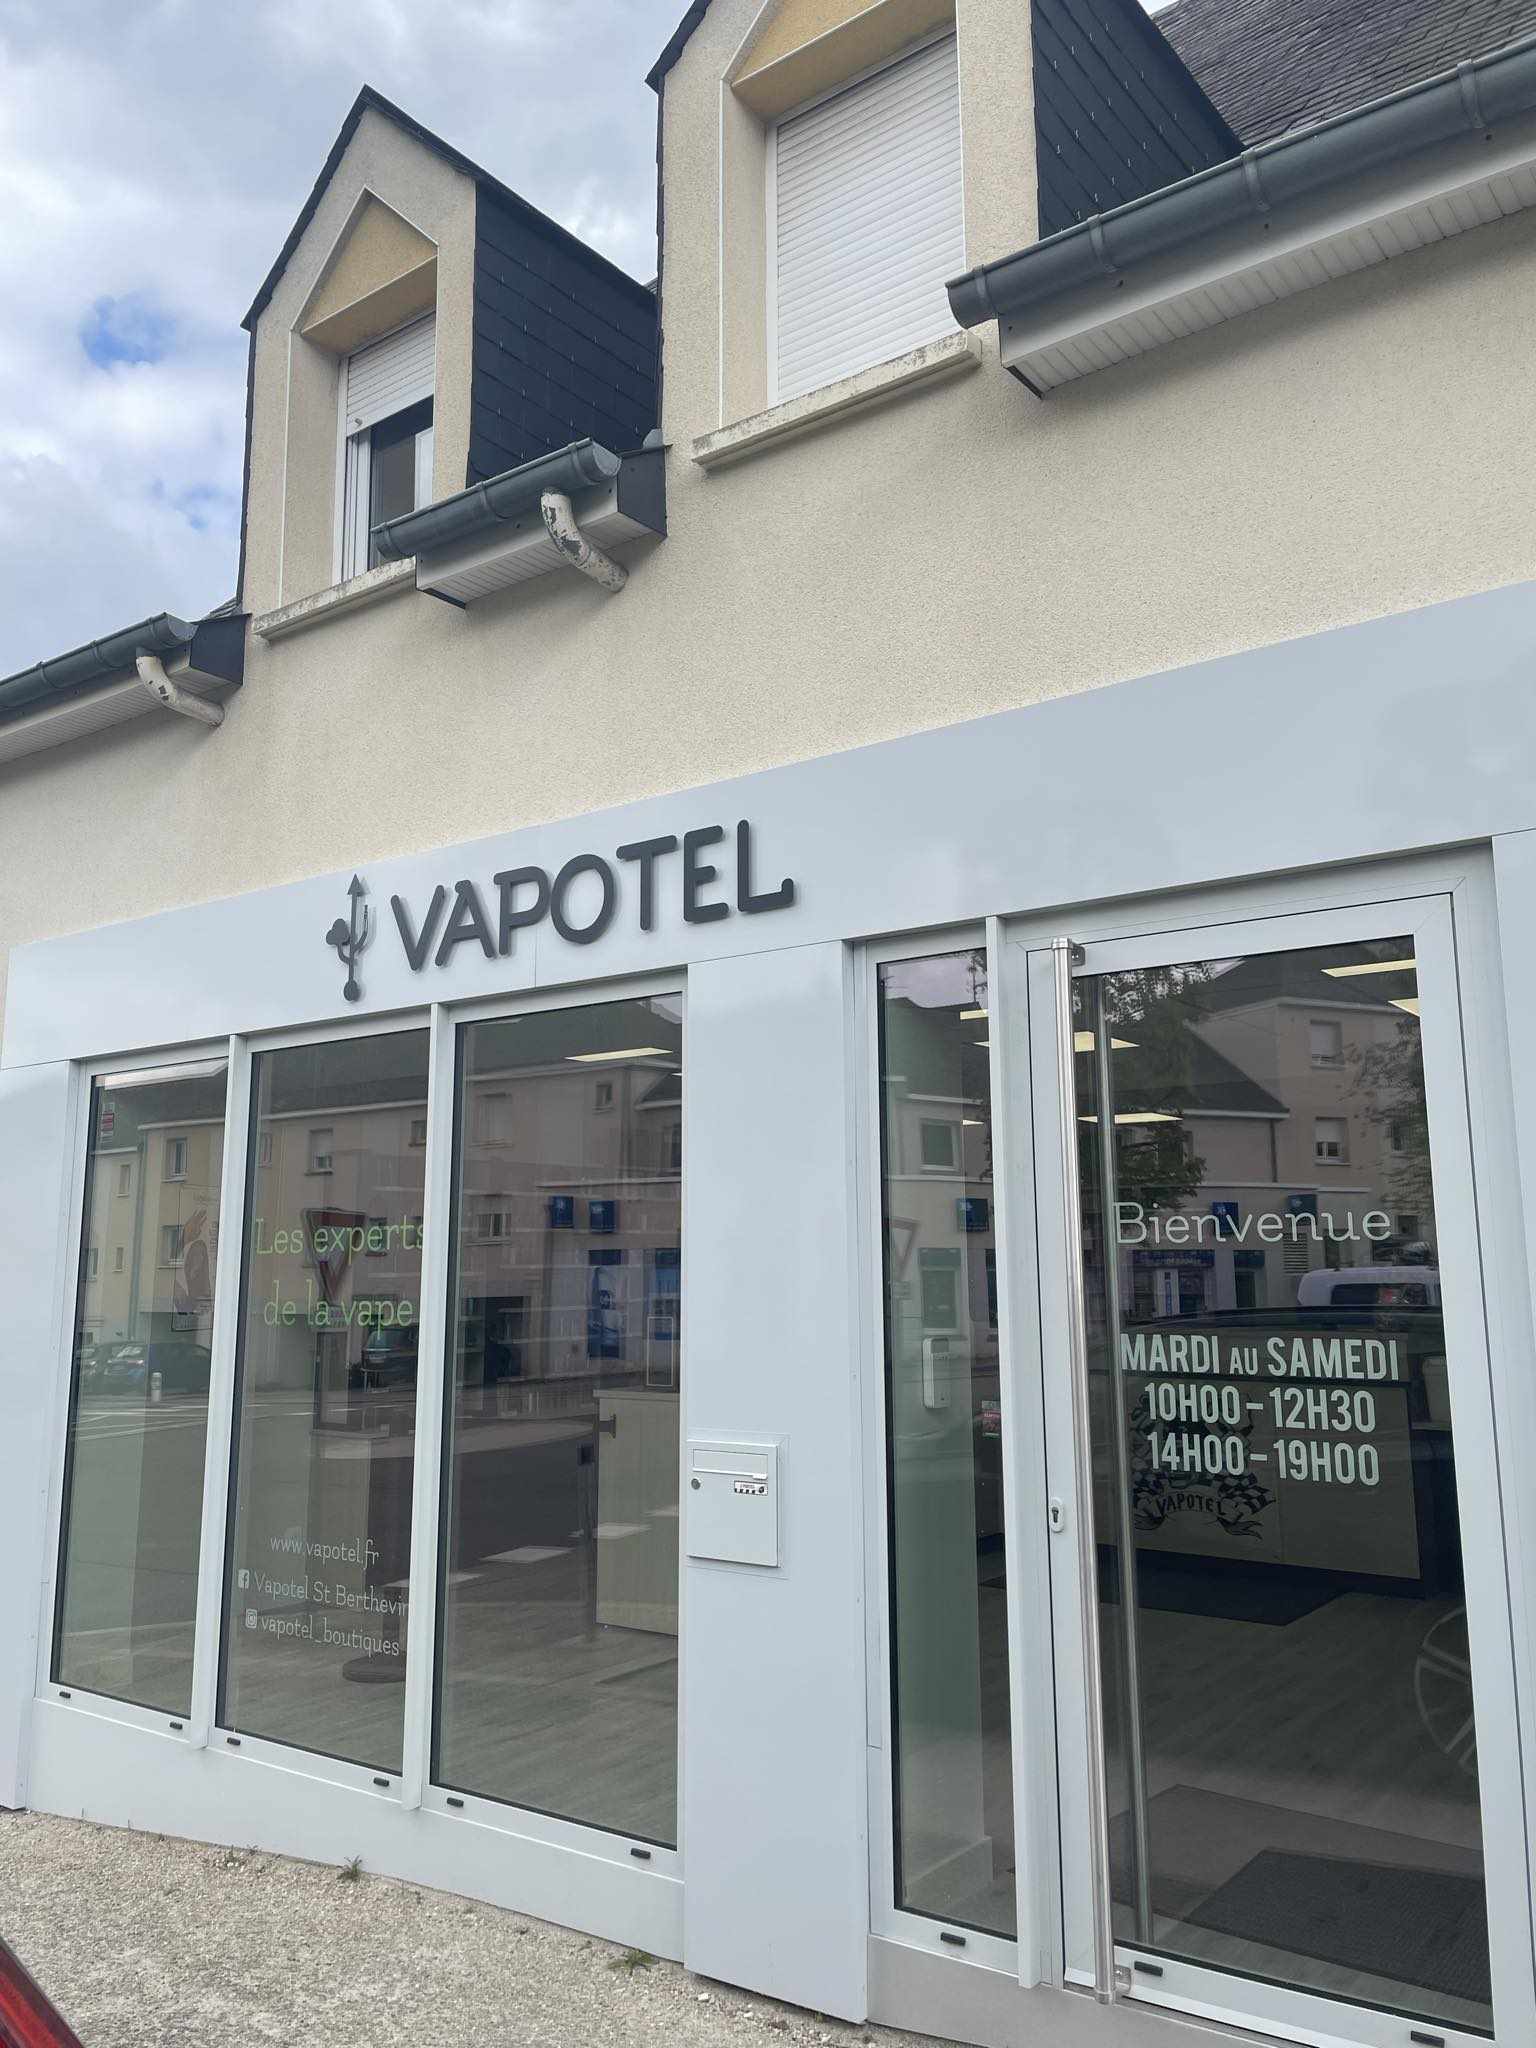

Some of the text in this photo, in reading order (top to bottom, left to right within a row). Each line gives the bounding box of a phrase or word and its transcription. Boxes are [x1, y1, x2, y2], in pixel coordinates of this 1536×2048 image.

[390, 819, 795, 972] VAPOTEL
[255, 1218, 304, 1254] Les
[1113, 1201, 1392, 1244] Bienvenue
[264, 1279, 413, 1340] de la vape
[1119, 1333, 1400, 1381] MARDI AU SAMEDI
[1156, 1492, 1227, 1516] VAPOTEL
[269, 1537, 381, 1570] www.vapotel.fr
[254, 1571, 310, 1601] Vapotel
[313, 1581, 331, 1604] St
[260, 1615, 400, 1658] vapotel_boutiques
